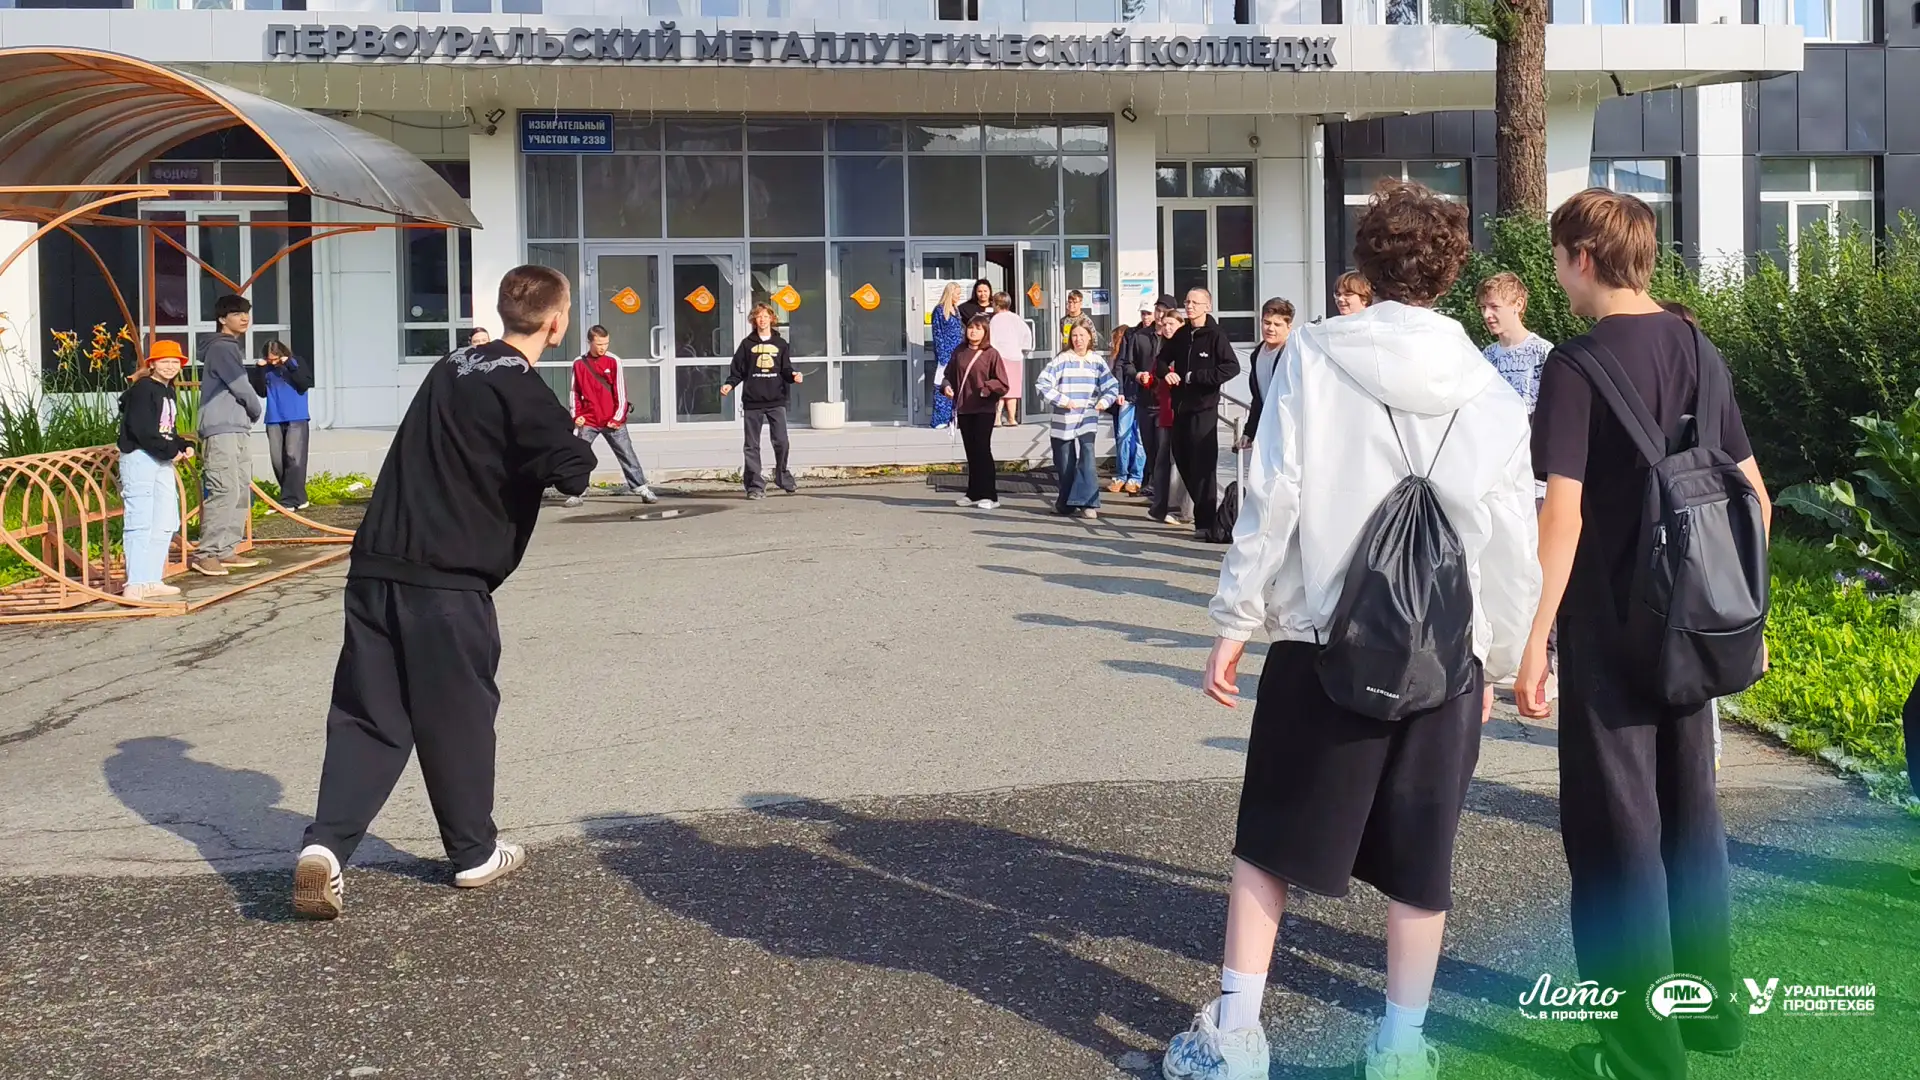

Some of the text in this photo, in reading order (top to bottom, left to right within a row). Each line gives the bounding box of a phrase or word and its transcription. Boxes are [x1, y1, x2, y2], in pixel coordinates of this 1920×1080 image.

[267, 21, 1337, 71] ПЕРВОУРАЛЬСКИЙ МЕТАЛЛУРГИЧЕСКИЙ КОЛЛЕДЖ
[528, 120, 605, 130] ИЗБИРАТЕЛЬНЫЙ
[528, 135, 569, 144] УЧАСТОК
